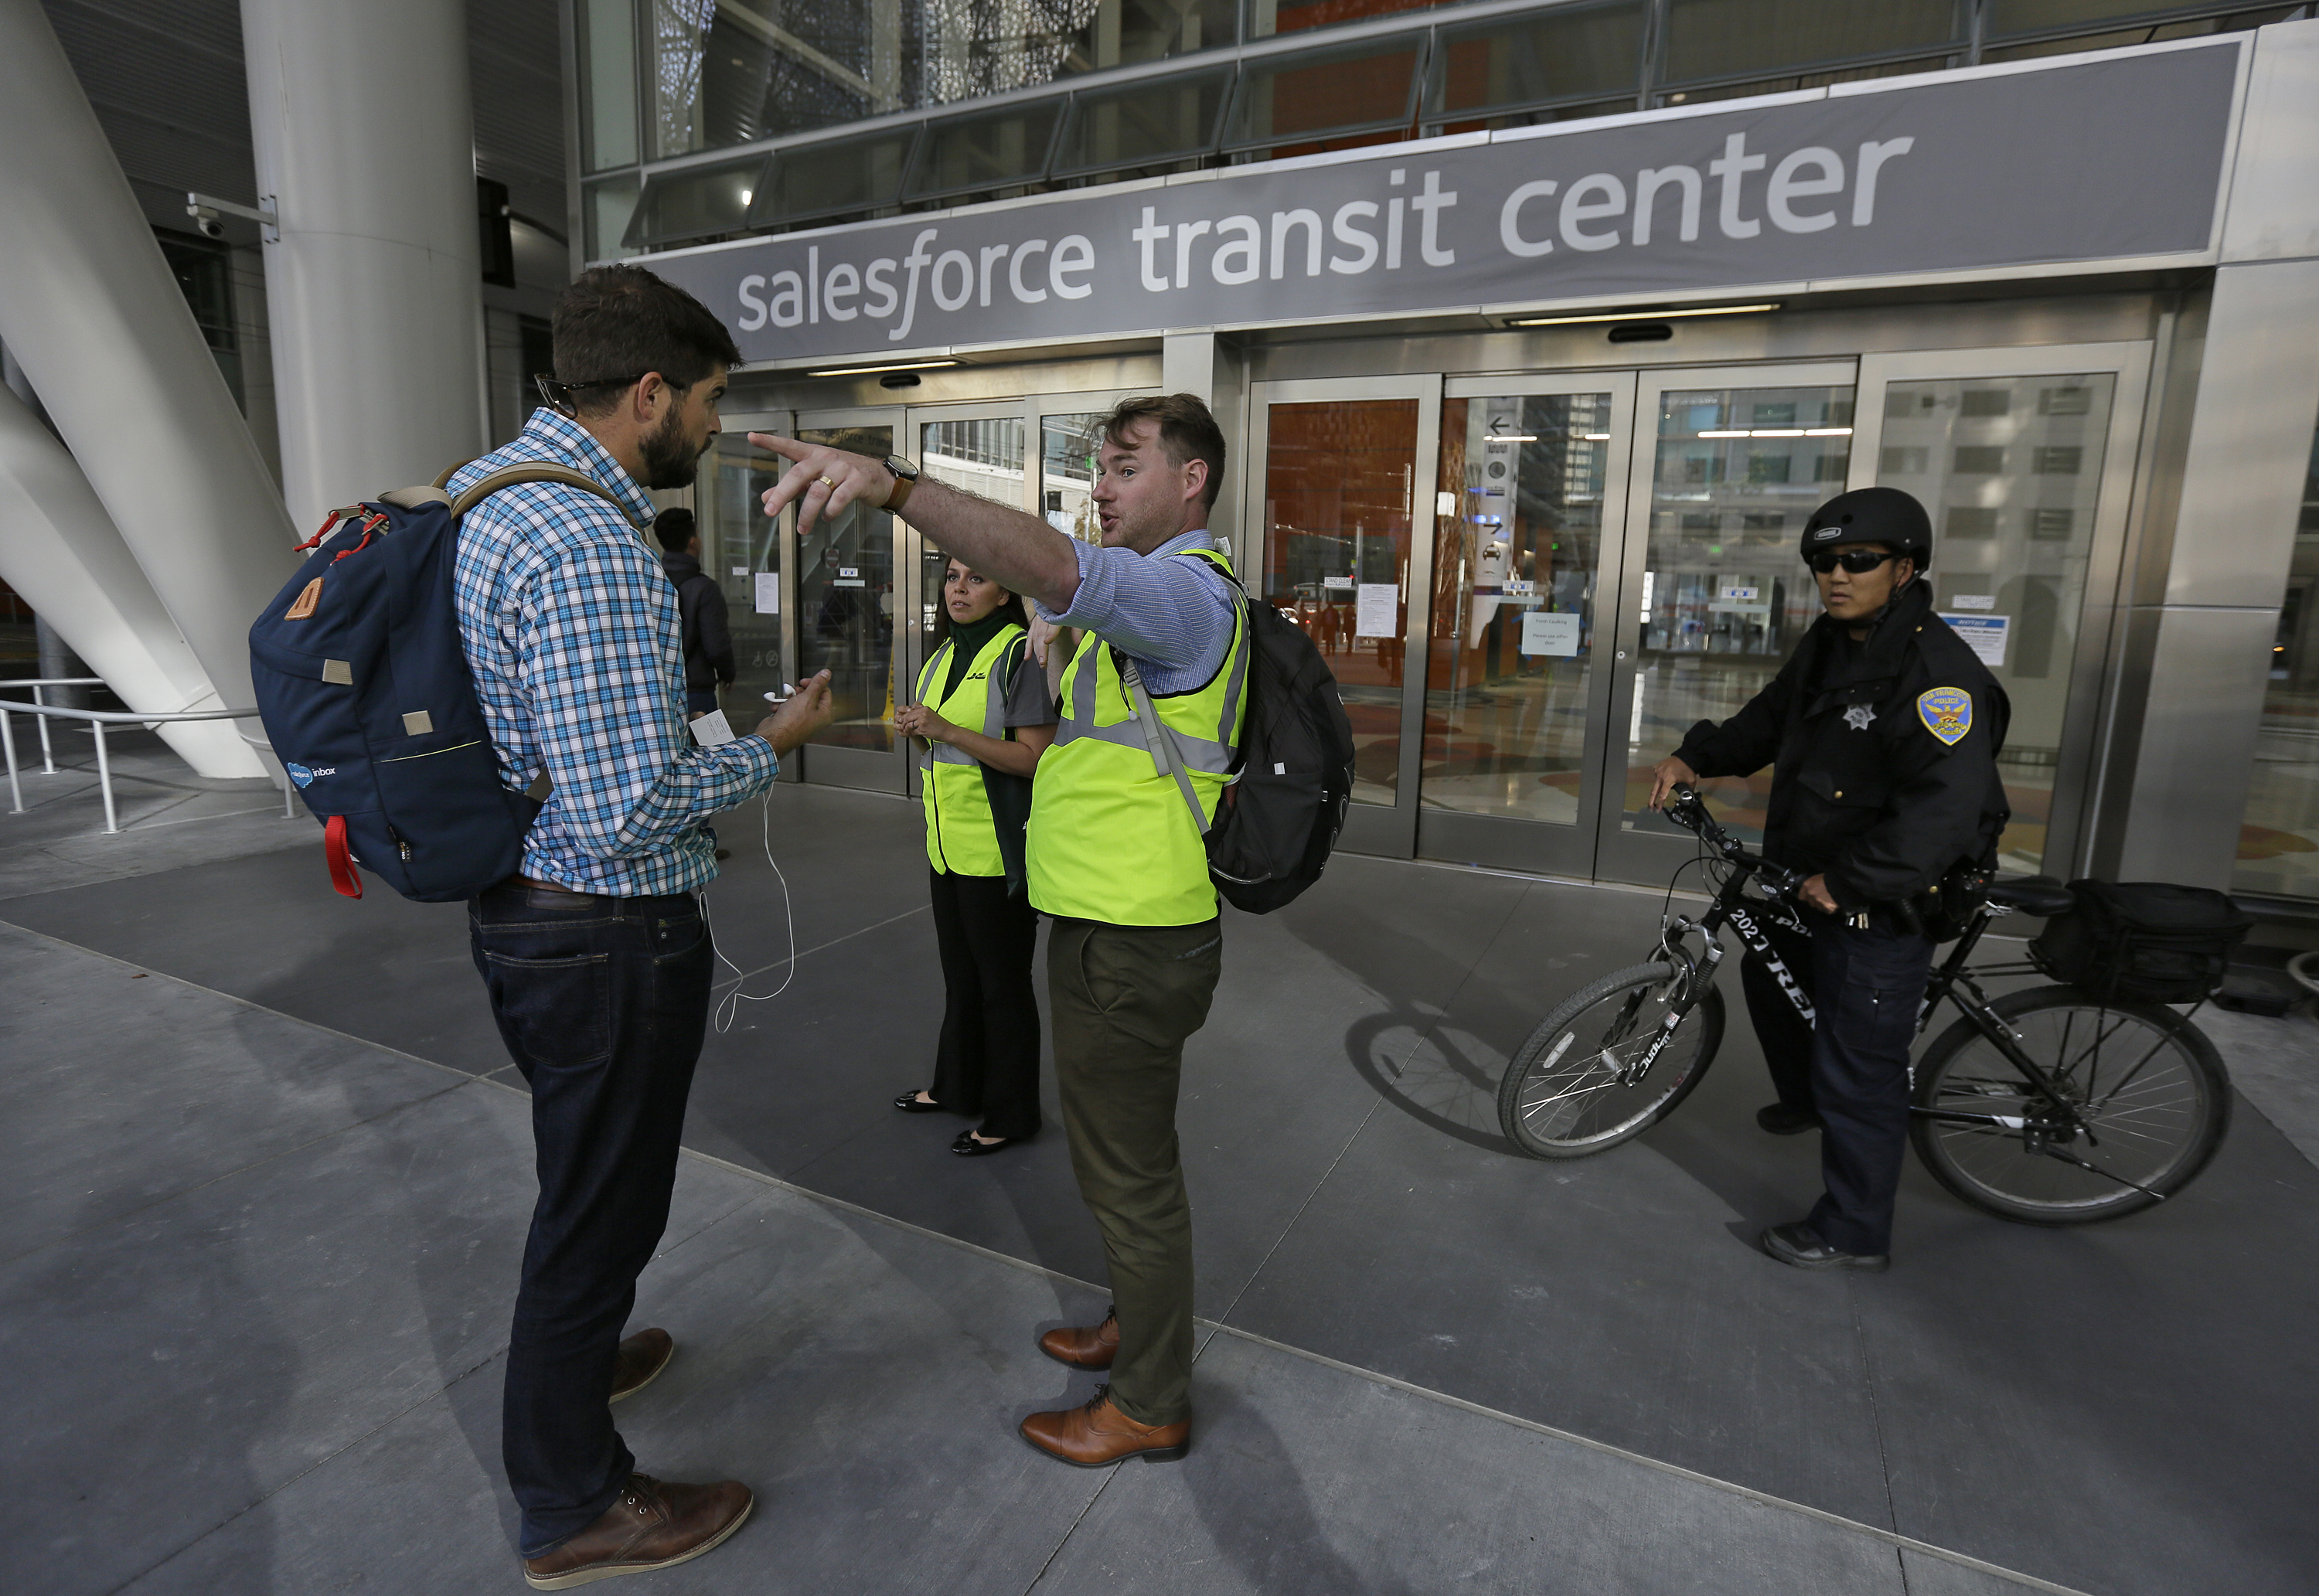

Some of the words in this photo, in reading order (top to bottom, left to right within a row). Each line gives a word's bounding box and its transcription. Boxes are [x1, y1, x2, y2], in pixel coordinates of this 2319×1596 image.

[737, 228, 1096, 342] salesforce
[1132, 168, 1458, 292] transit
[1500, 131, 1915, 258] center
[1922, 692, 1936, 703] SAN
[1936, 689, 1970, 702] FRANCISCO
[312, 767, 336, 778] inbox
